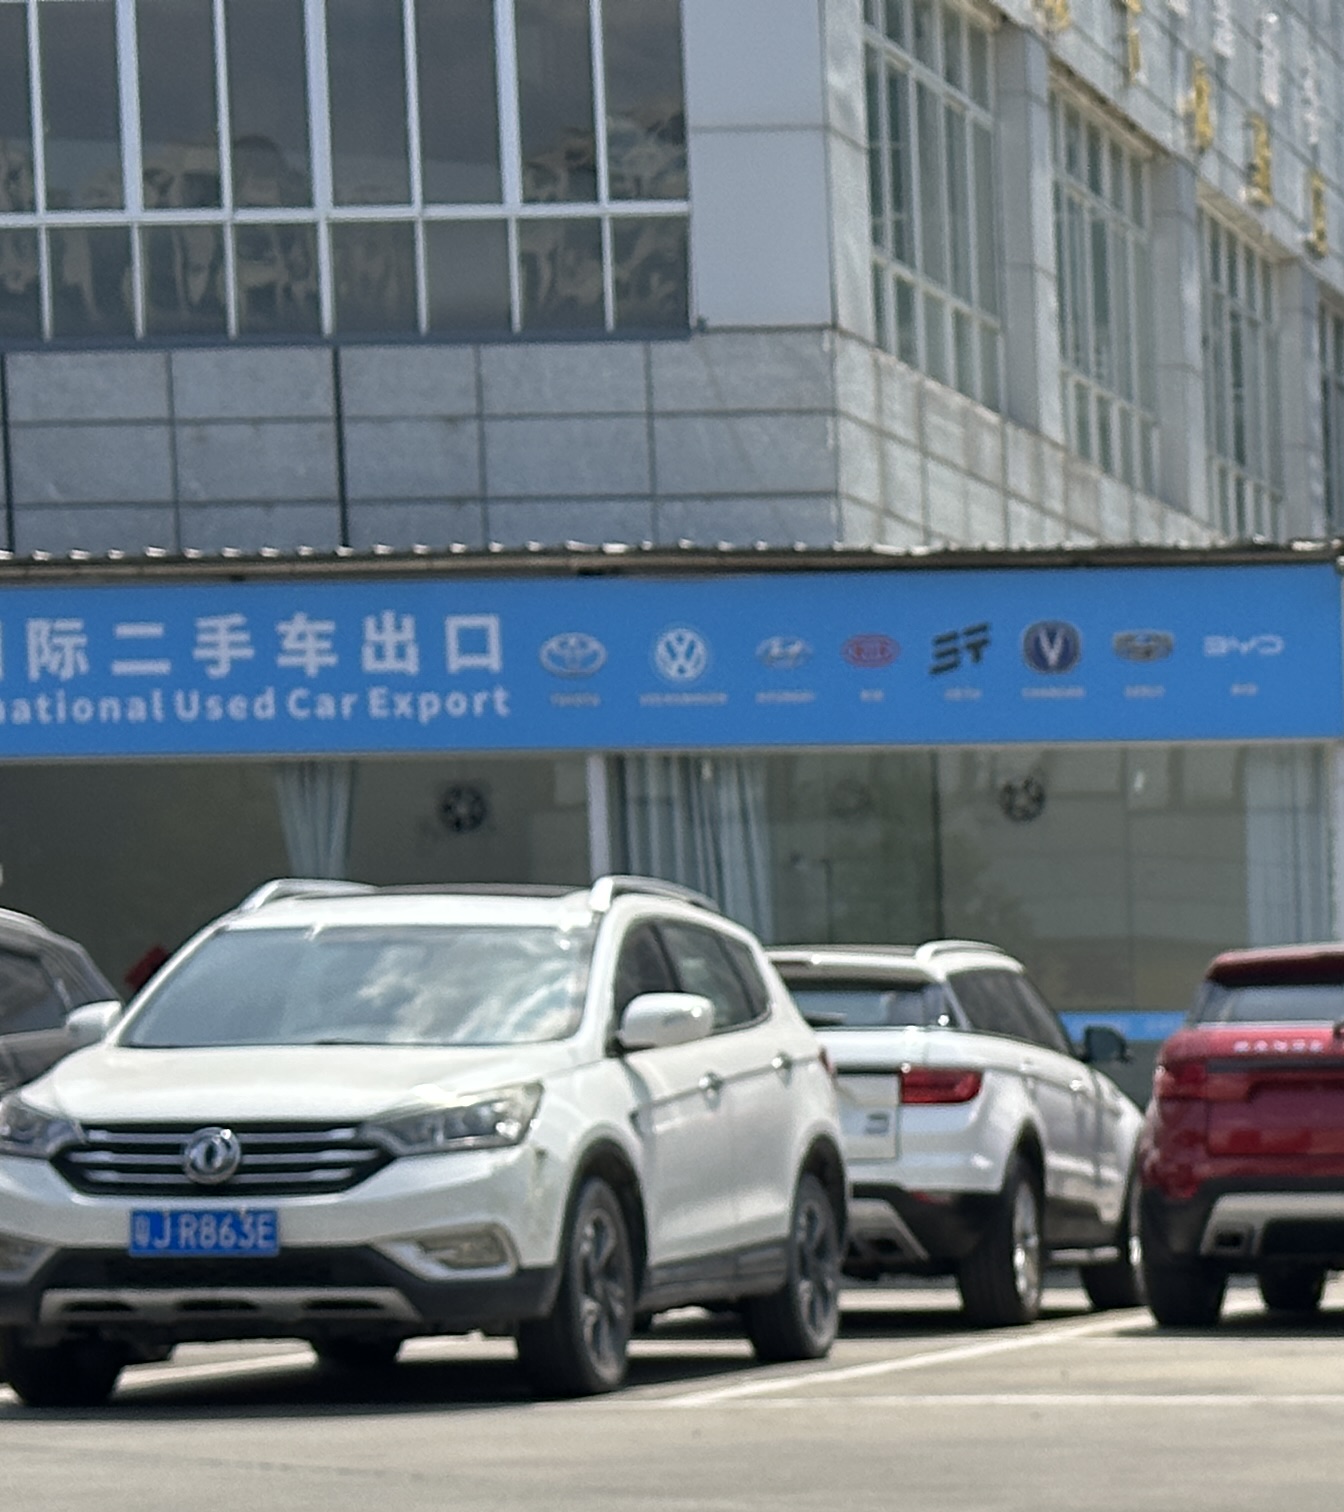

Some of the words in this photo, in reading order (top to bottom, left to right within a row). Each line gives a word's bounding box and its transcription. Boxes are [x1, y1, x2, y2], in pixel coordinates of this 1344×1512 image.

[0, 610, 502, 682] 际二手车出口
[0, 688, 164, 724] ational
[174, 686, 275, 722] Used
[287, 686, 358, 720] Car
[368, 684, 510, 725] Export
